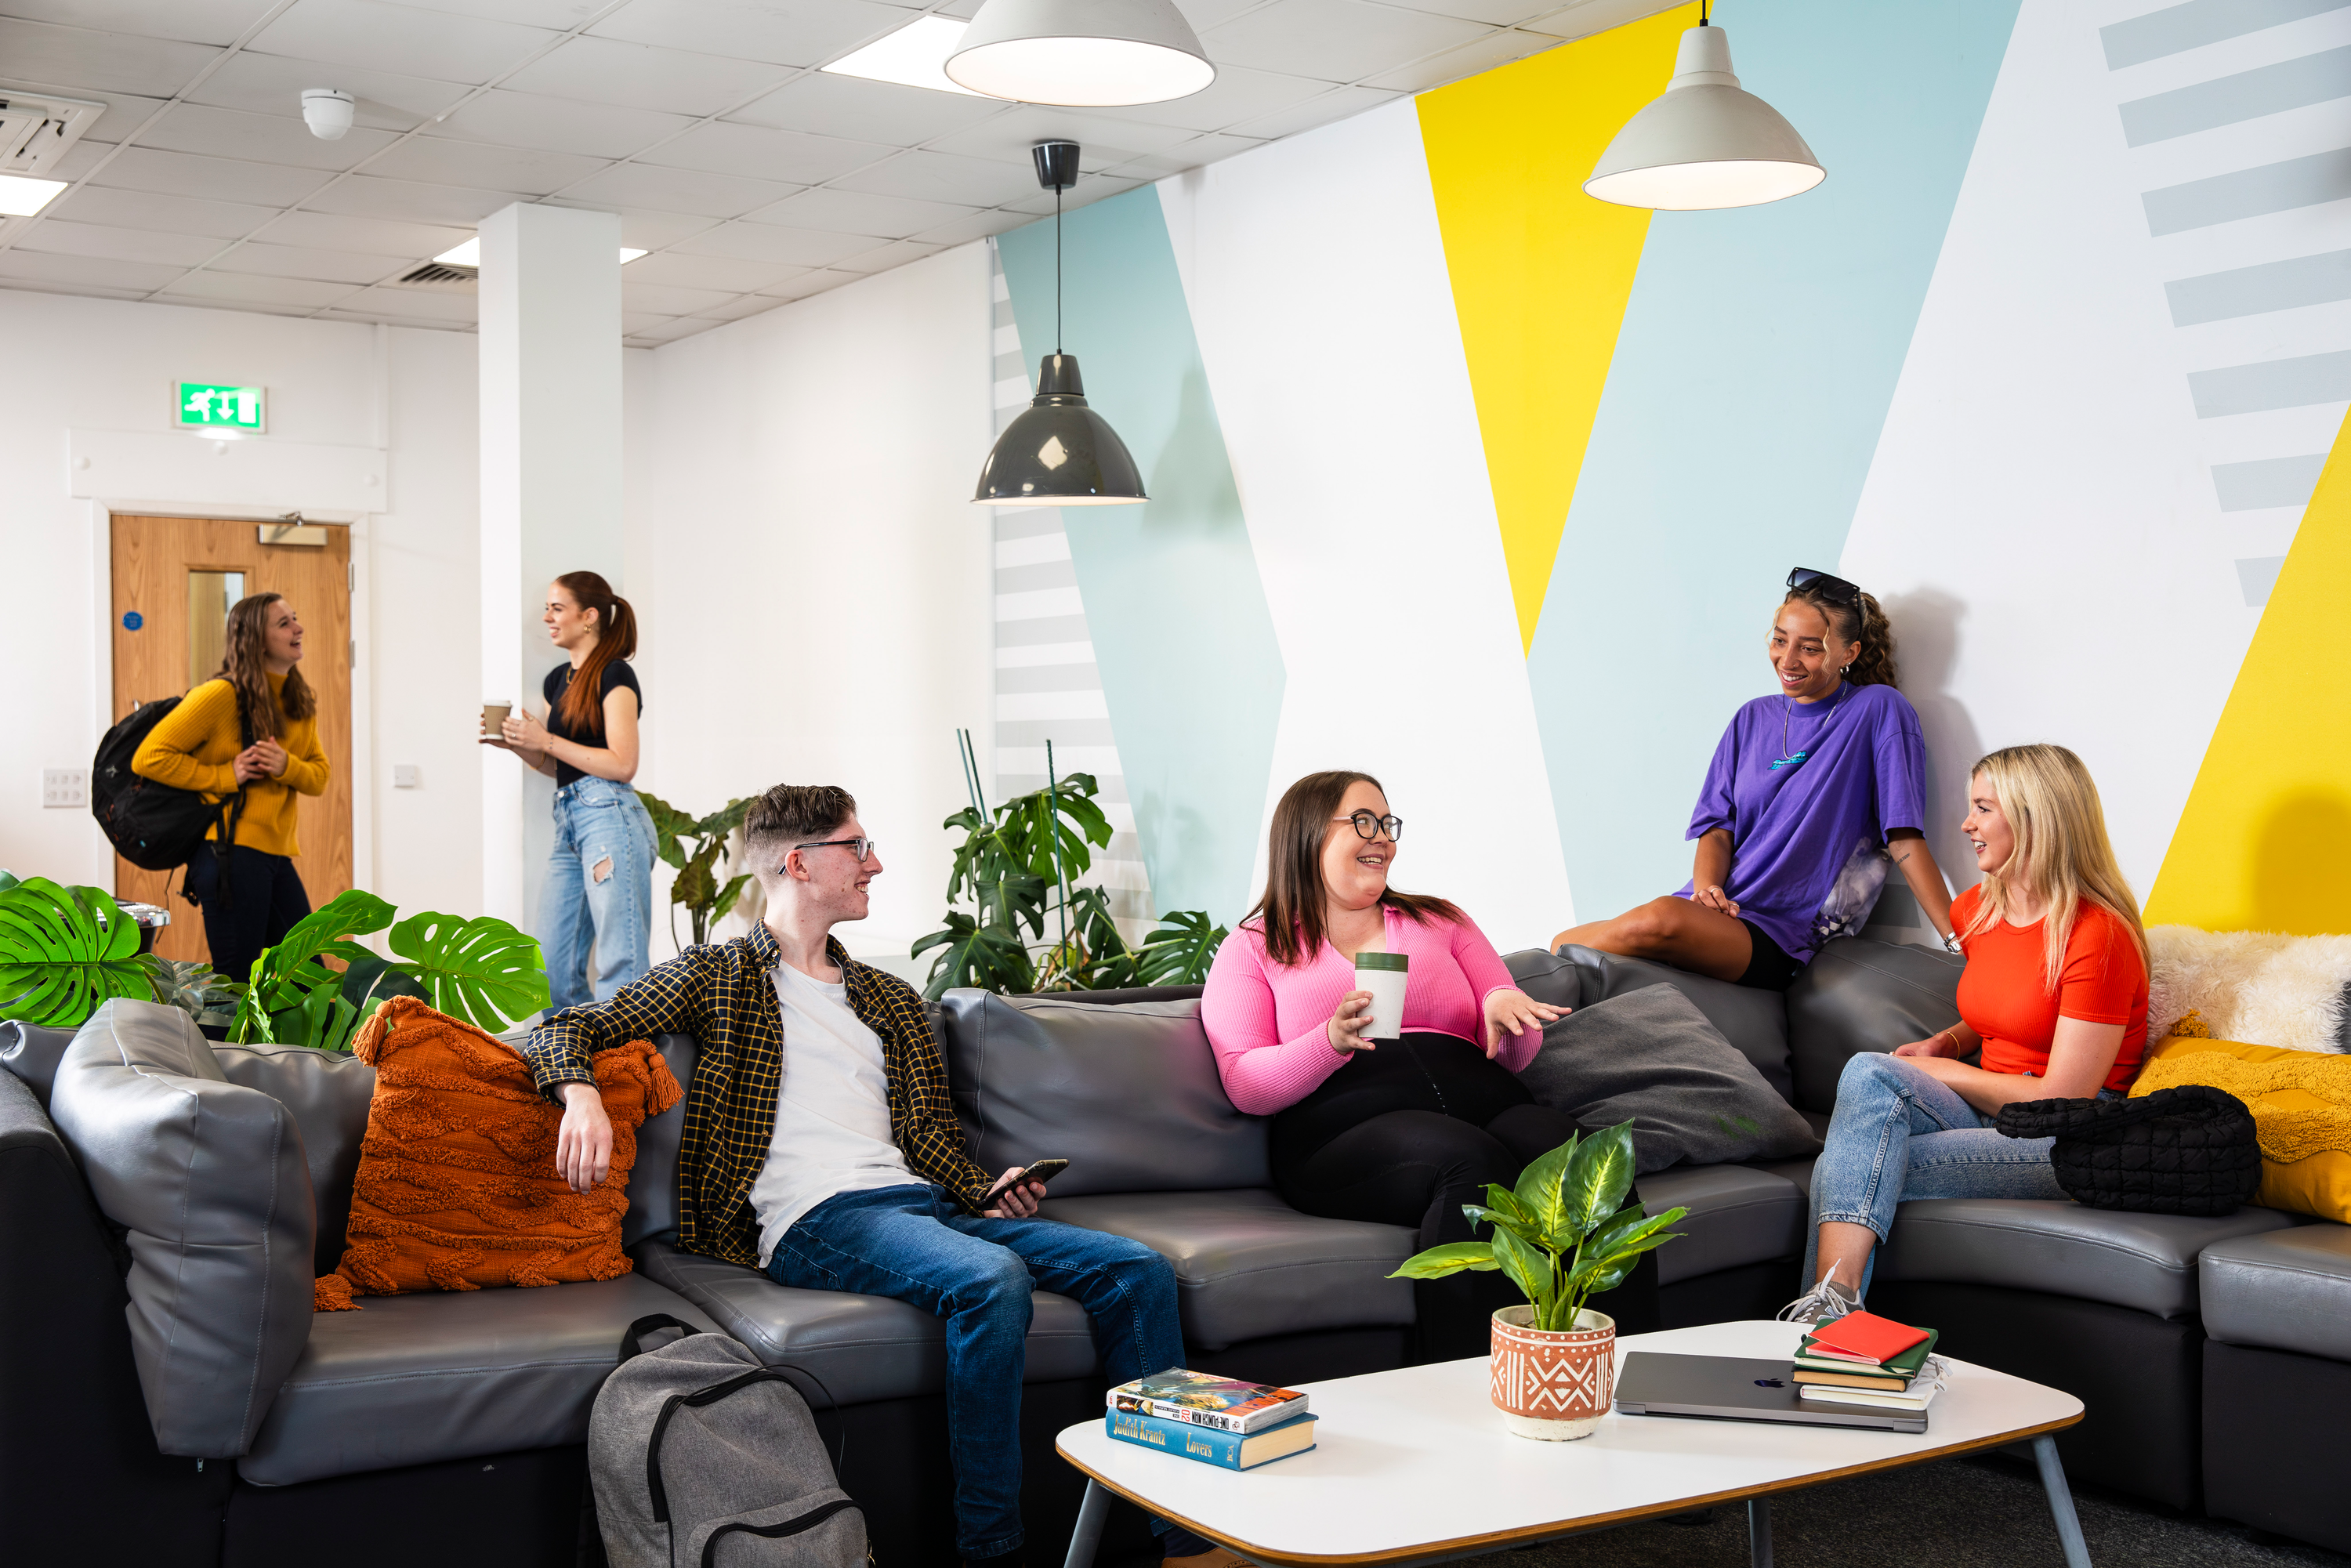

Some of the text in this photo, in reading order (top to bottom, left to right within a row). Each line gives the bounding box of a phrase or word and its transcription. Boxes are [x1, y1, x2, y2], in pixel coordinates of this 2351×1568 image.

[1181, 1409, 1190, 1422] 02
[1202, 1413, 1229, 1430] ONE-PUNCH
[1114, 1414, 1165, 1446] Judith Krantz
[1186, 1432, 1212, 1458] Lovers
